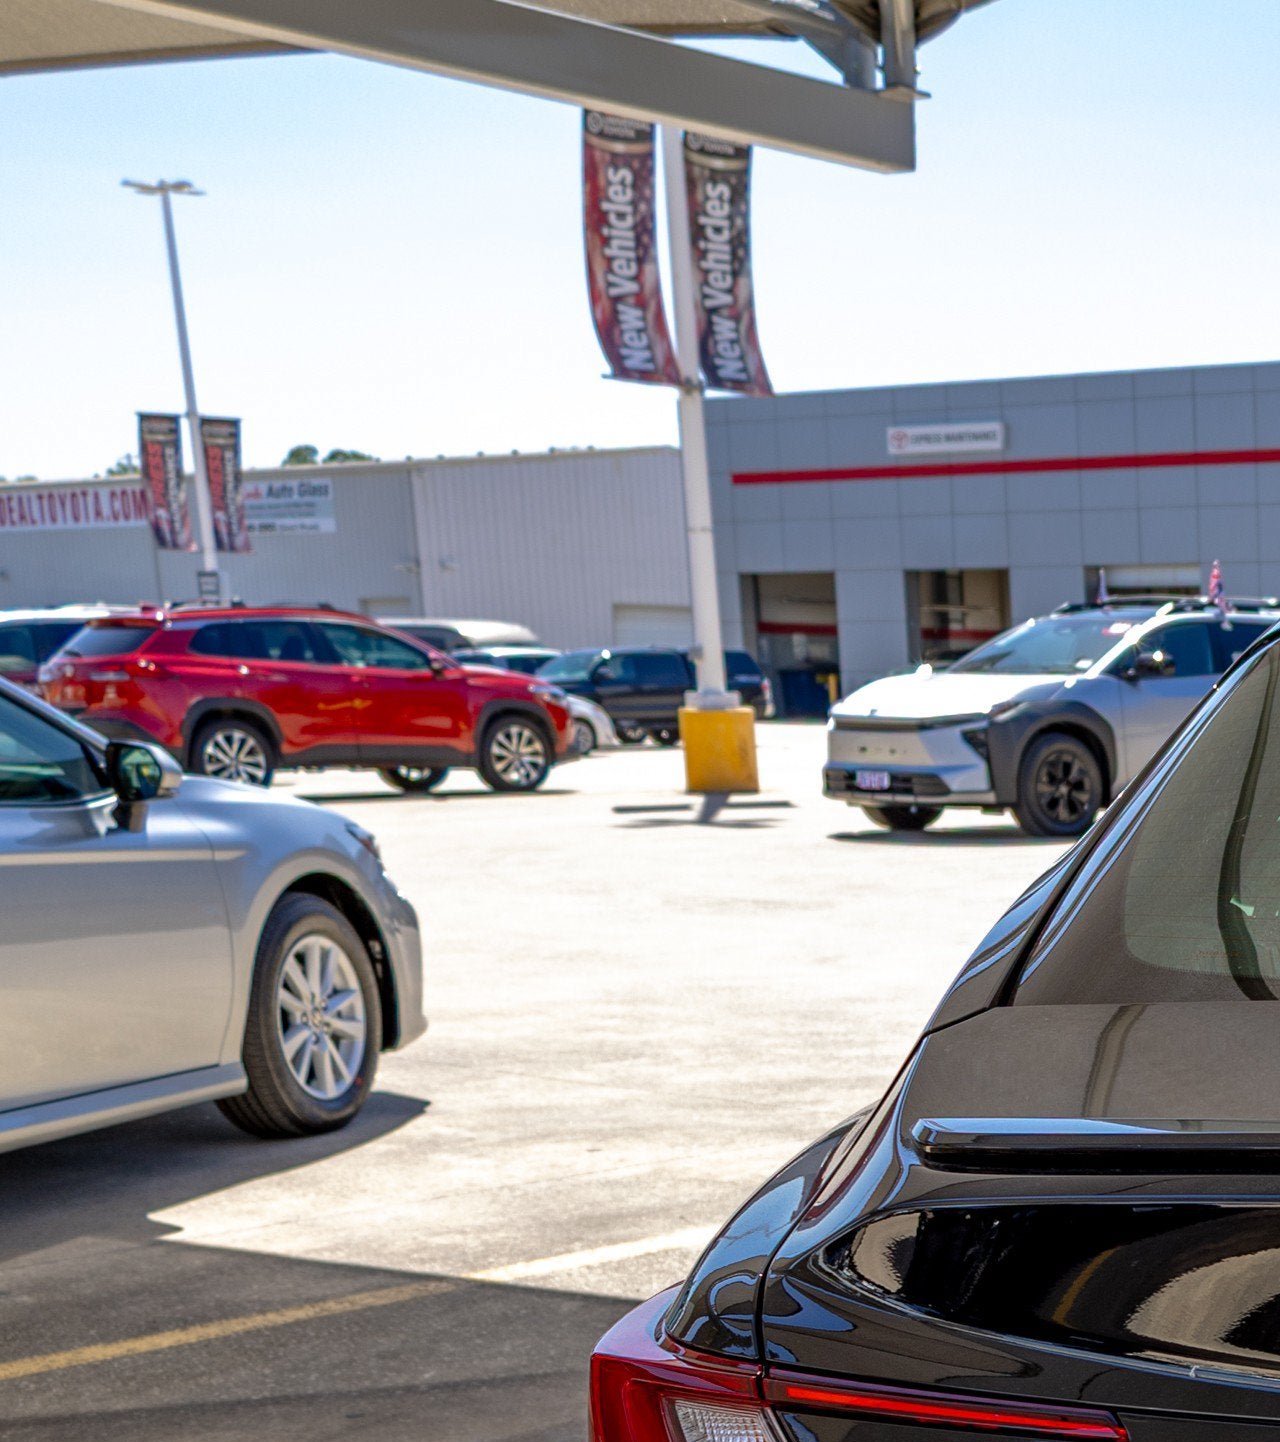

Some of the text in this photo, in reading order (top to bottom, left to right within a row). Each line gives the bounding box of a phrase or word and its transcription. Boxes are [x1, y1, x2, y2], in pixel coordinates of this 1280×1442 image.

[600, 164, 639, 298] Vehicles
[697, 180, 735, 310] Vehicles
[614, 302, 656, 373] New
[711, 312, 750, 383] New
[267, 484, 294, 498] Auto
[297, 481, 329, 497] Glass
